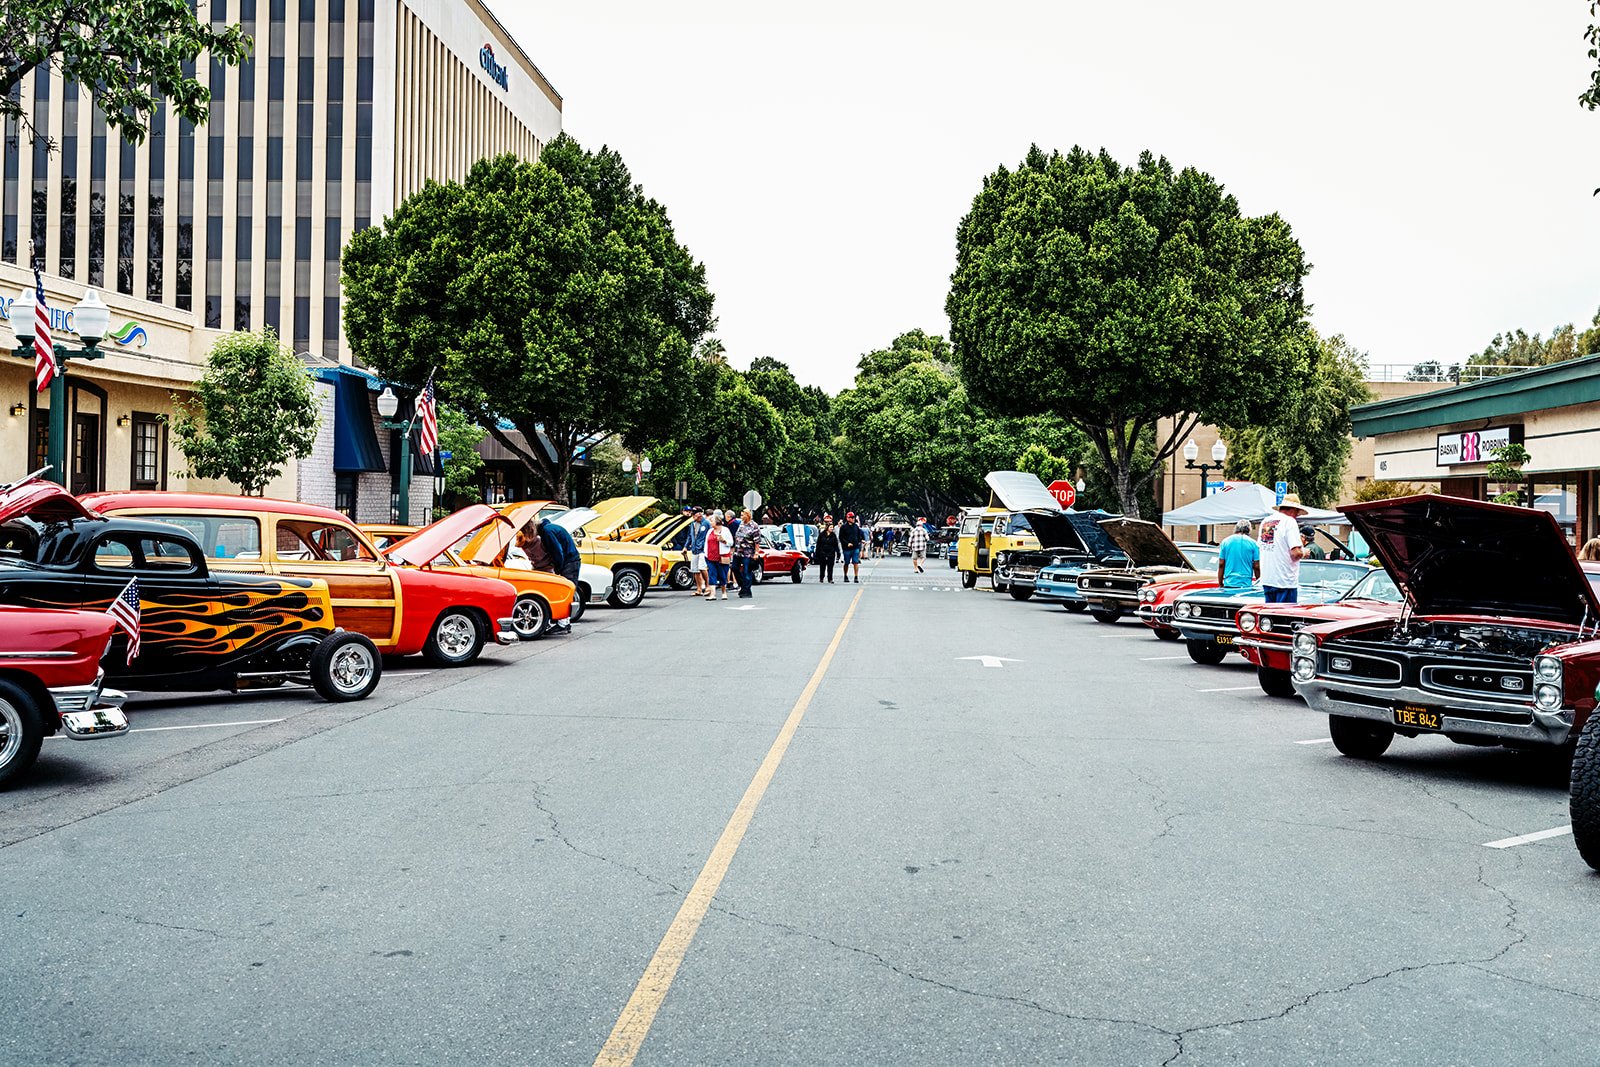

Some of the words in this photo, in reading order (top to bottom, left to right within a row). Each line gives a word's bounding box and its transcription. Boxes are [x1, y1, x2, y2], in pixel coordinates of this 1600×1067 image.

[1439, 443, 1459, 456] BASKIN
[1454, 674, 1493, 683] GTO
[1396, 709, 1417, 724] TBE
[1419, 713, 1438, 727] 842
